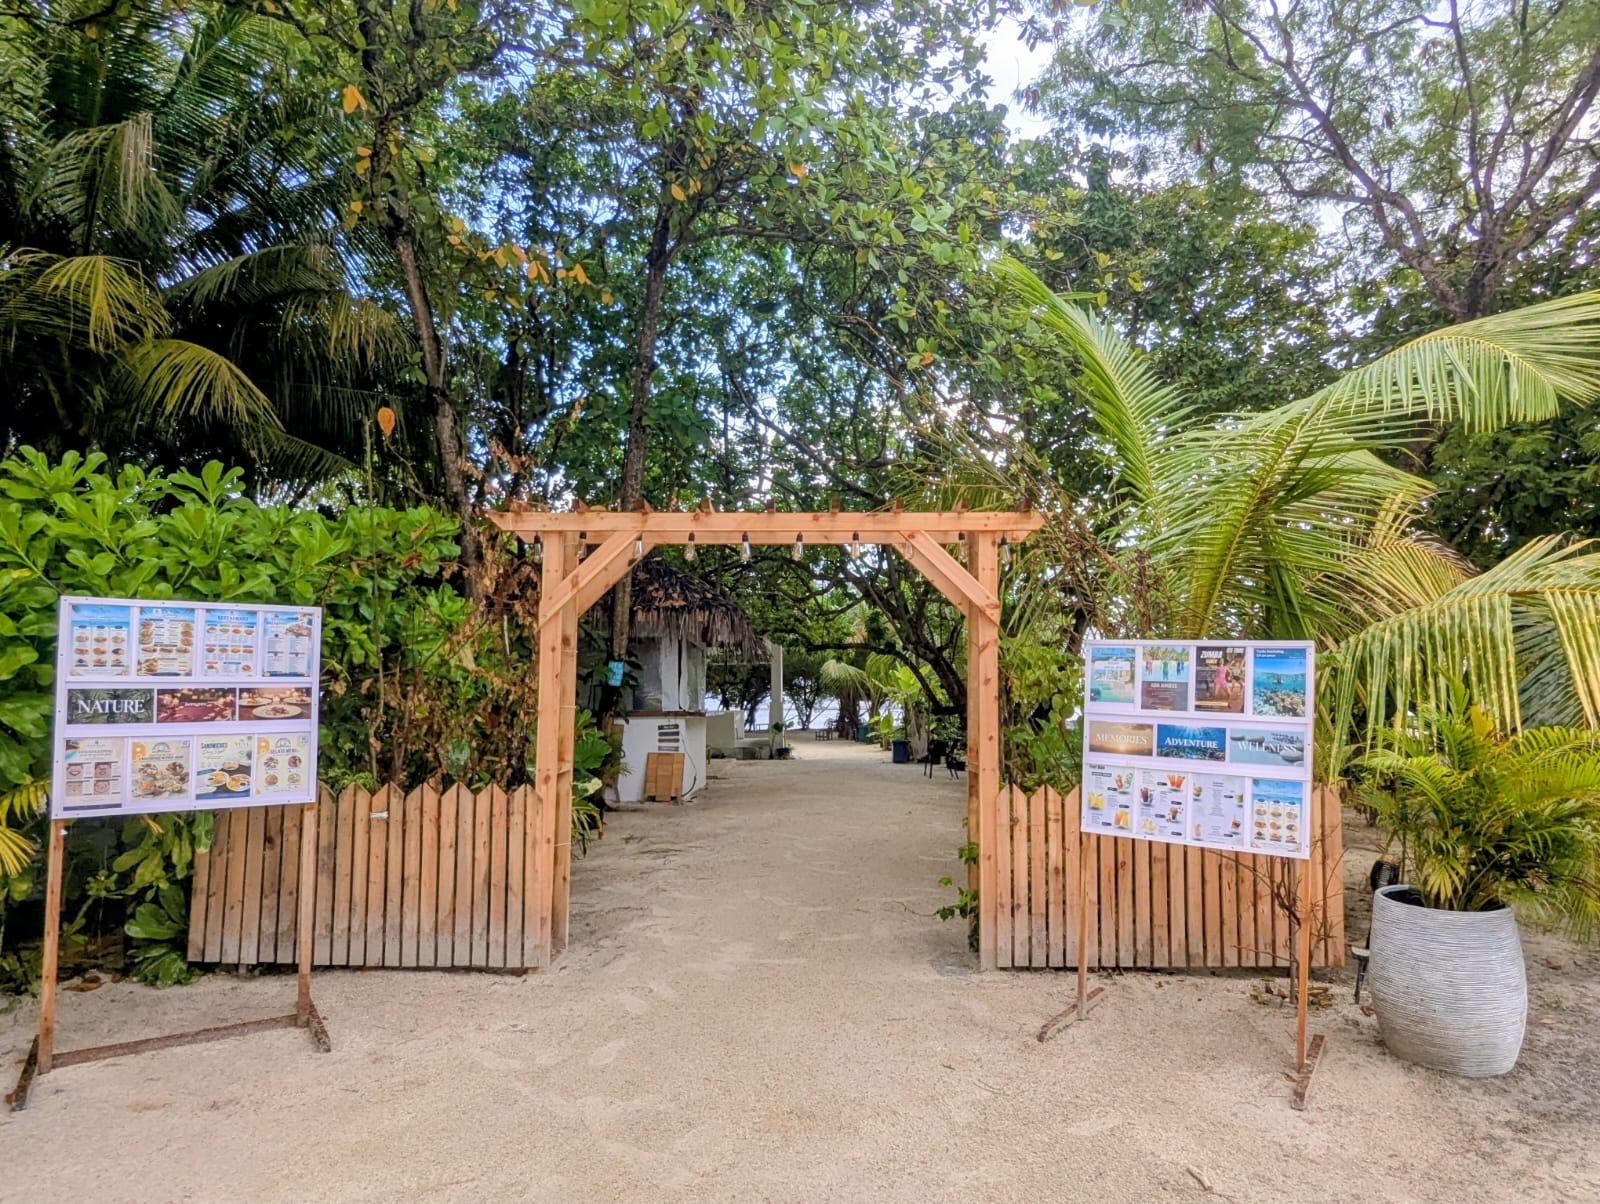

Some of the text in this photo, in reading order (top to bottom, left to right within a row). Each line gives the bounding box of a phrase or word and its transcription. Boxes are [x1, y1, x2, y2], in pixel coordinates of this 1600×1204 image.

[78, 699, 146, 714] NATURE
[1096, 733, 1148, 745] MEMORIES
[1164, 737, 1219, 749] ADVENTURE
[1237, 742, 1297, 754] WELLNESS
